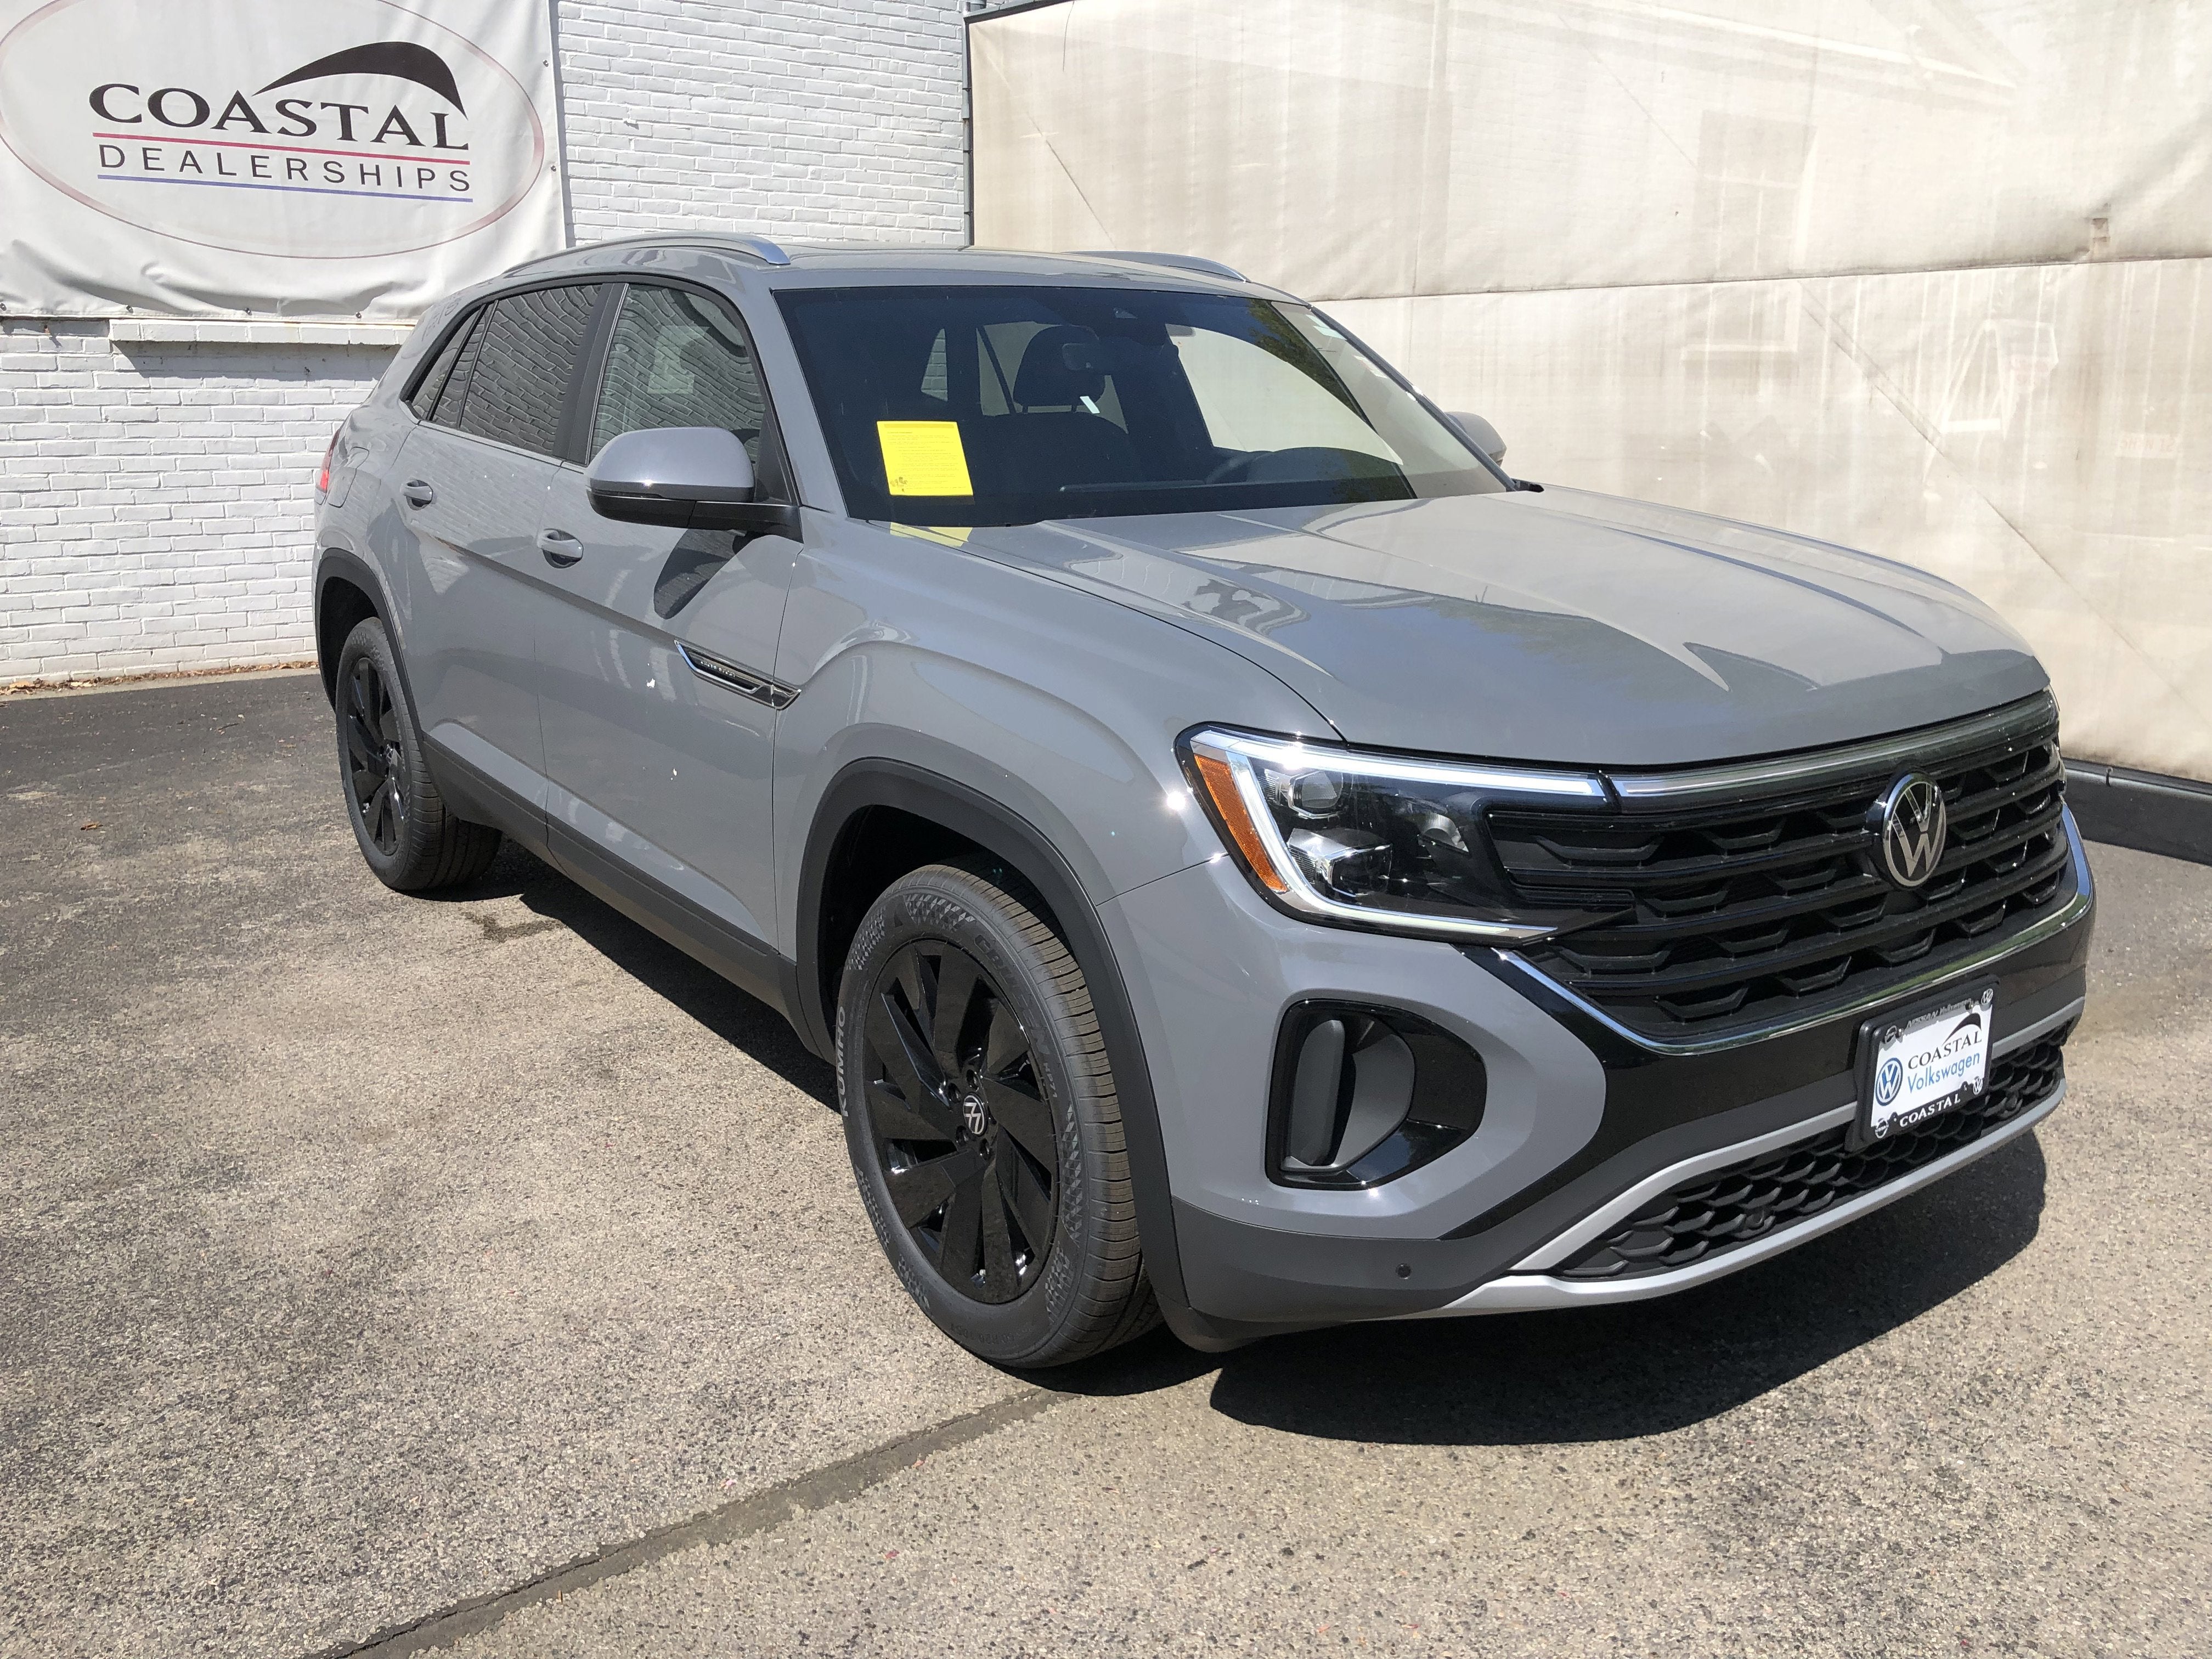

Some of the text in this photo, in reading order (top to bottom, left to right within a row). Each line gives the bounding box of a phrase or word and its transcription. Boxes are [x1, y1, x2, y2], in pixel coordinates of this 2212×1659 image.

[89, 83, 469, 150] COASTAL
[99, 144, 471, 191] DEALERSHIPS
[837, 1006, 849, 1117] KUMHO
[1908, 1030, 1982, 1069] COASTAL
[1908, 1053, 1980, 1093] Volkswagen
[1900, 1093, 1961, 1127] COASTAL
